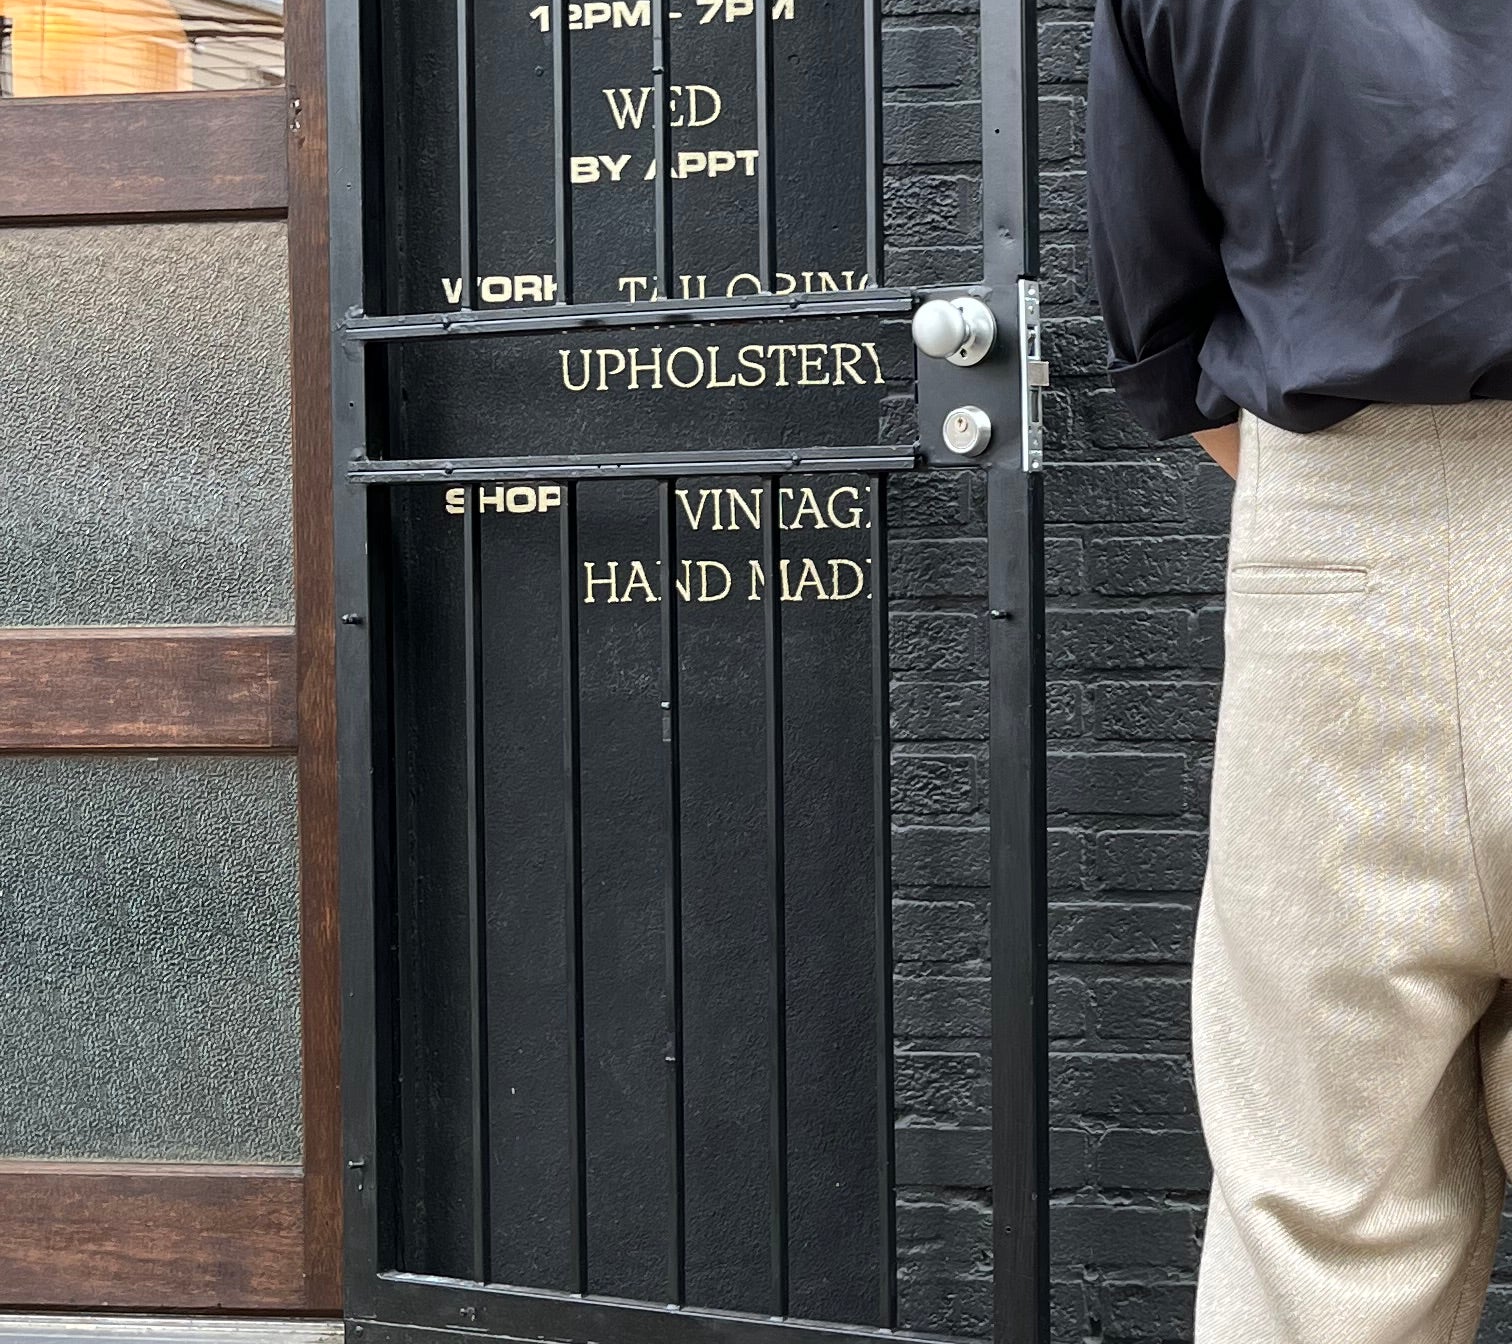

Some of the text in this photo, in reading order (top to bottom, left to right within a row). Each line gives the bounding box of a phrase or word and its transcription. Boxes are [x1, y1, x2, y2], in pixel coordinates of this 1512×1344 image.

[570, 154, 632, 184] BY
[445, 485, 561, 514] SHOP
[674, 486, 872, 531] VINTAG
[748, 558, 872, 602] MAD
